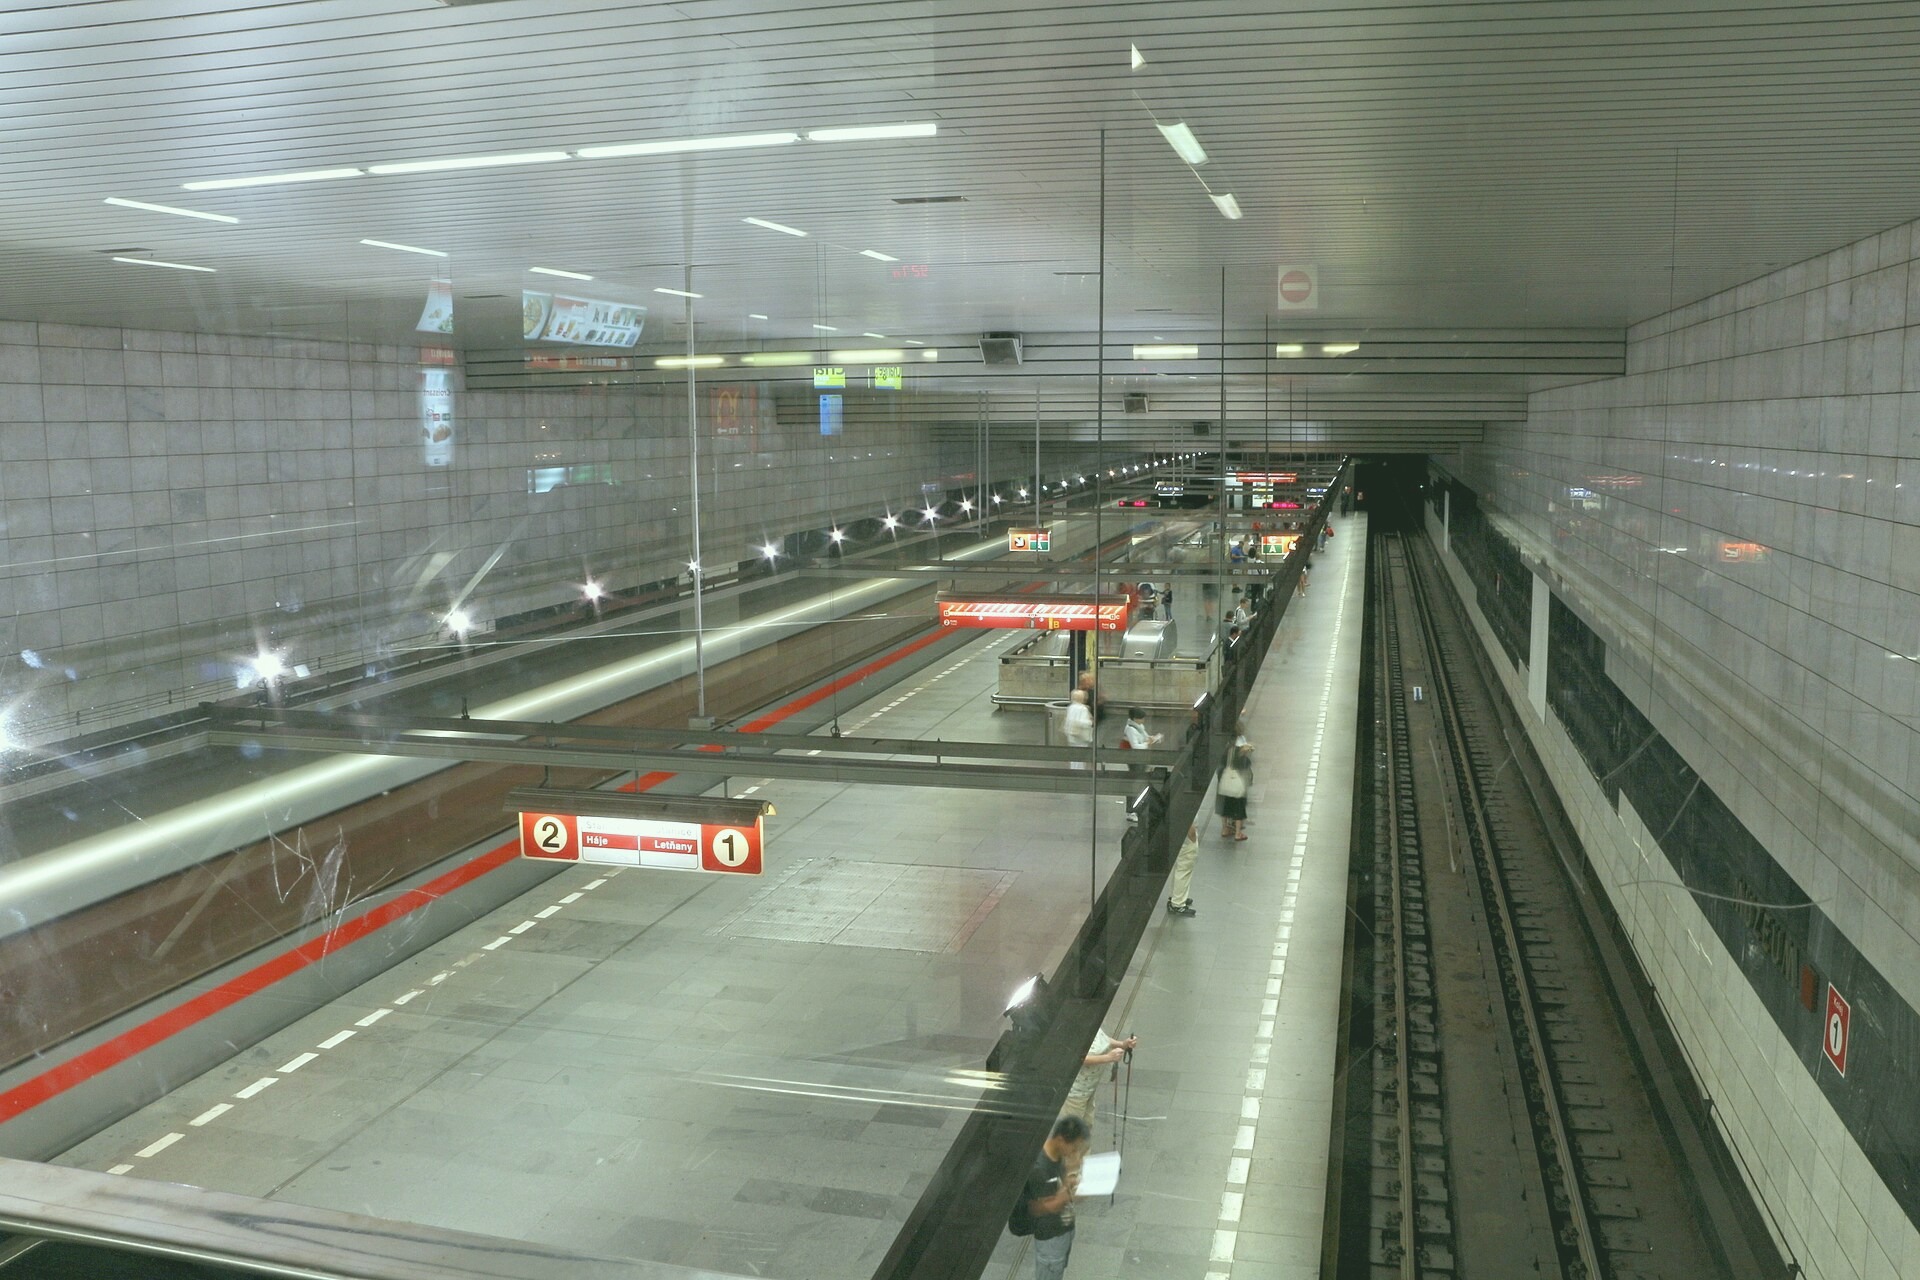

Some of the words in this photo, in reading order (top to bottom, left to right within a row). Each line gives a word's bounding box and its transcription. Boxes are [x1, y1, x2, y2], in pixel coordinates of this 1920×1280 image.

[542, 821, 559, 848] 2
[586, 835, 608, 847] Háje
[654, 839, 693, 853] Letňany
[722, 834, 735, 862] 1
[1833, 1020, 1839, 1049] 1
